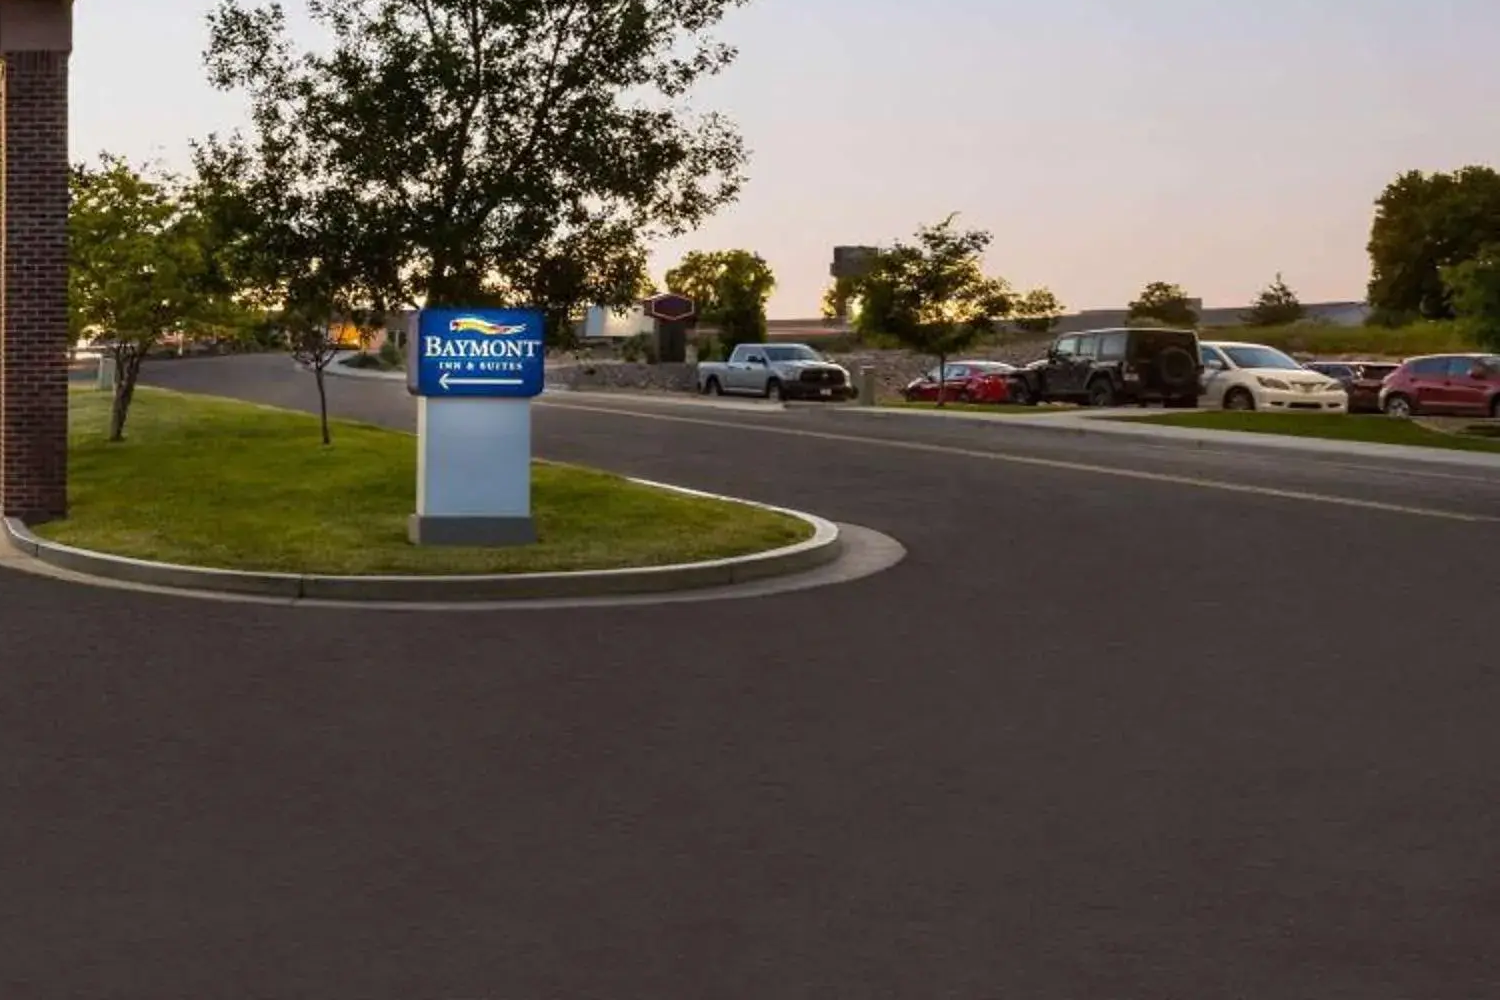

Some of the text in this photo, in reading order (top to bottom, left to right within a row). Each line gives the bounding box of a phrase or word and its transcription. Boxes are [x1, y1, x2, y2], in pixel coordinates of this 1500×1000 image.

[424, 335, 541, 357] BAYMONT
[439, 361, 461, 371] INN
[479, 361, 523, 371] SUITES
